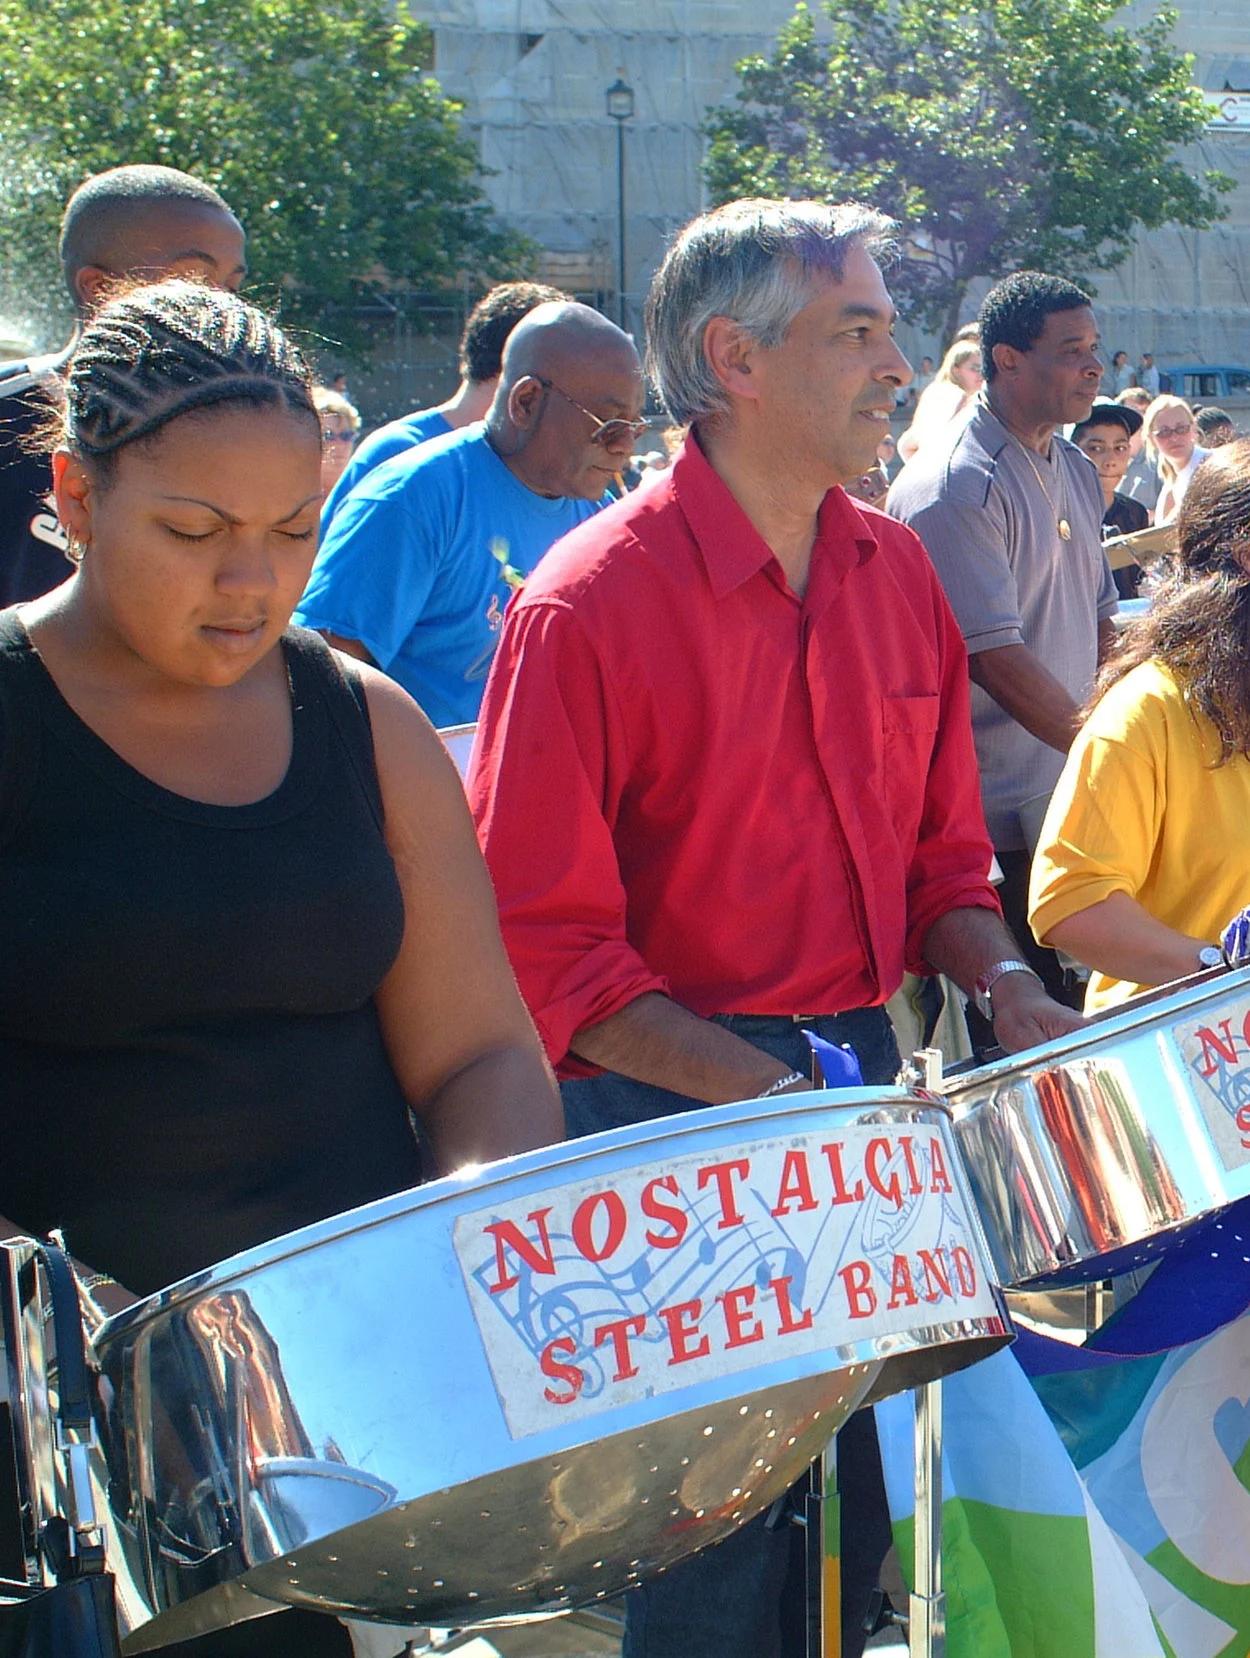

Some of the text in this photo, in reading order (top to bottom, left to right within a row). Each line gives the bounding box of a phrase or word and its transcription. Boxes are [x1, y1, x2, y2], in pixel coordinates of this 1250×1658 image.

[483, 1135, 953, 1294] NOSTALGIA
[540, 1247, 976, 1404] STEEL BAND
